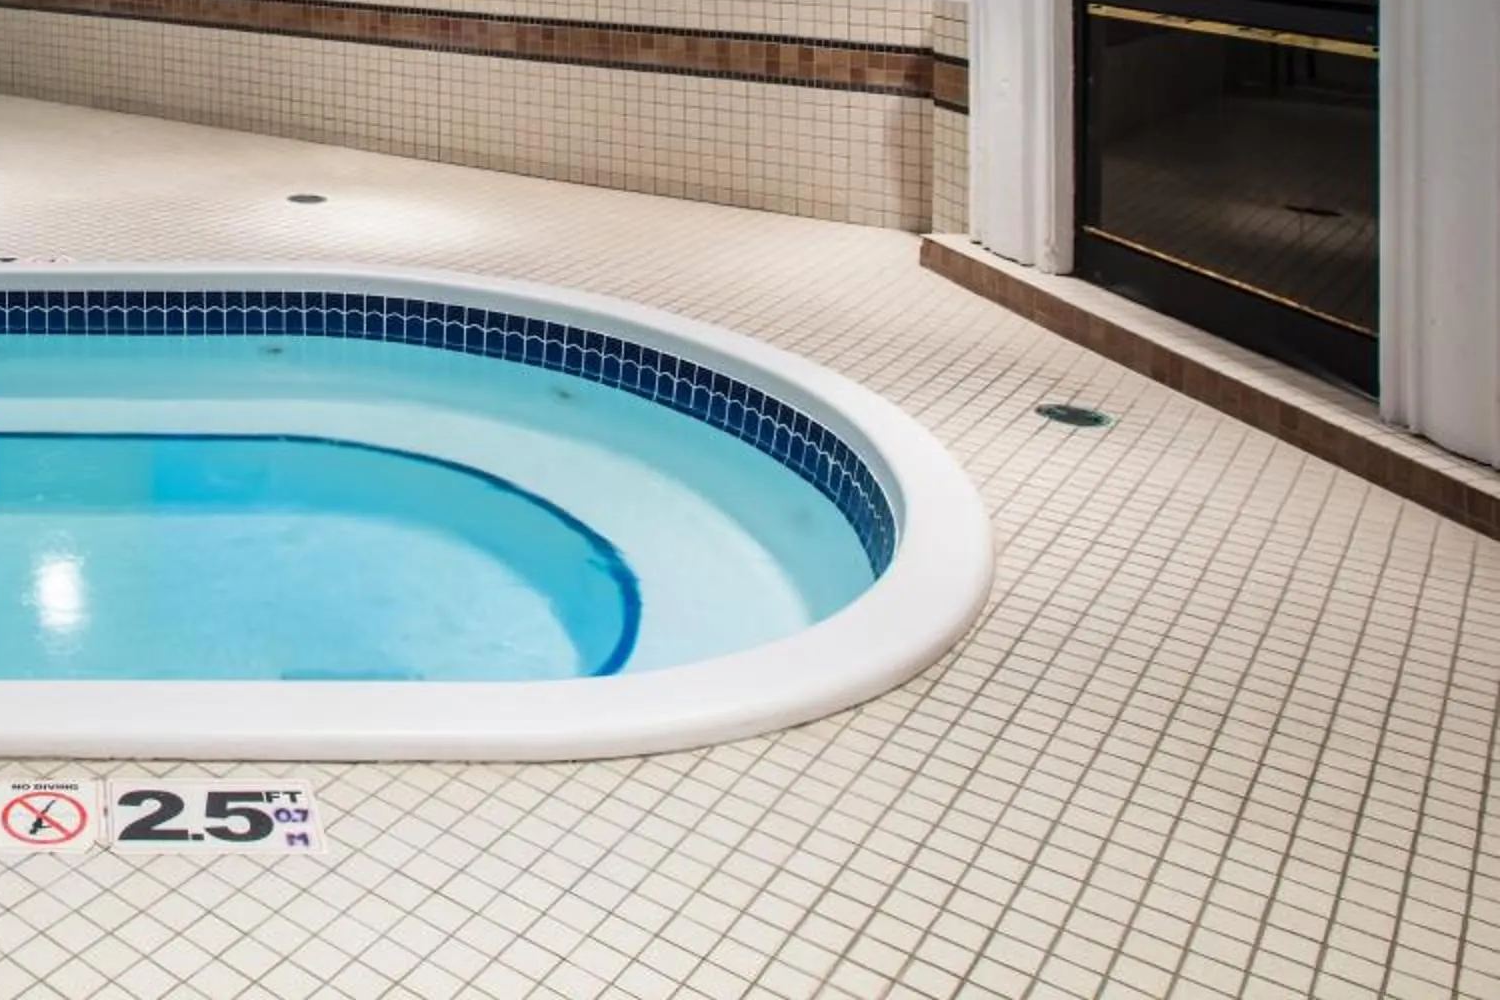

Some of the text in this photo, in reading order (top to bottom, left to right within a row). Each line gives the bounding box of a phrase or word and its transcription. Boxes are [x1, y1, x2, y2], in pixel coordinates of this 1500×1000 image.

[11, 783, 79, 791] NO DIVING
[118, 790, 303, 842] 2.5 FT
[286, 832, 309, 846] M
